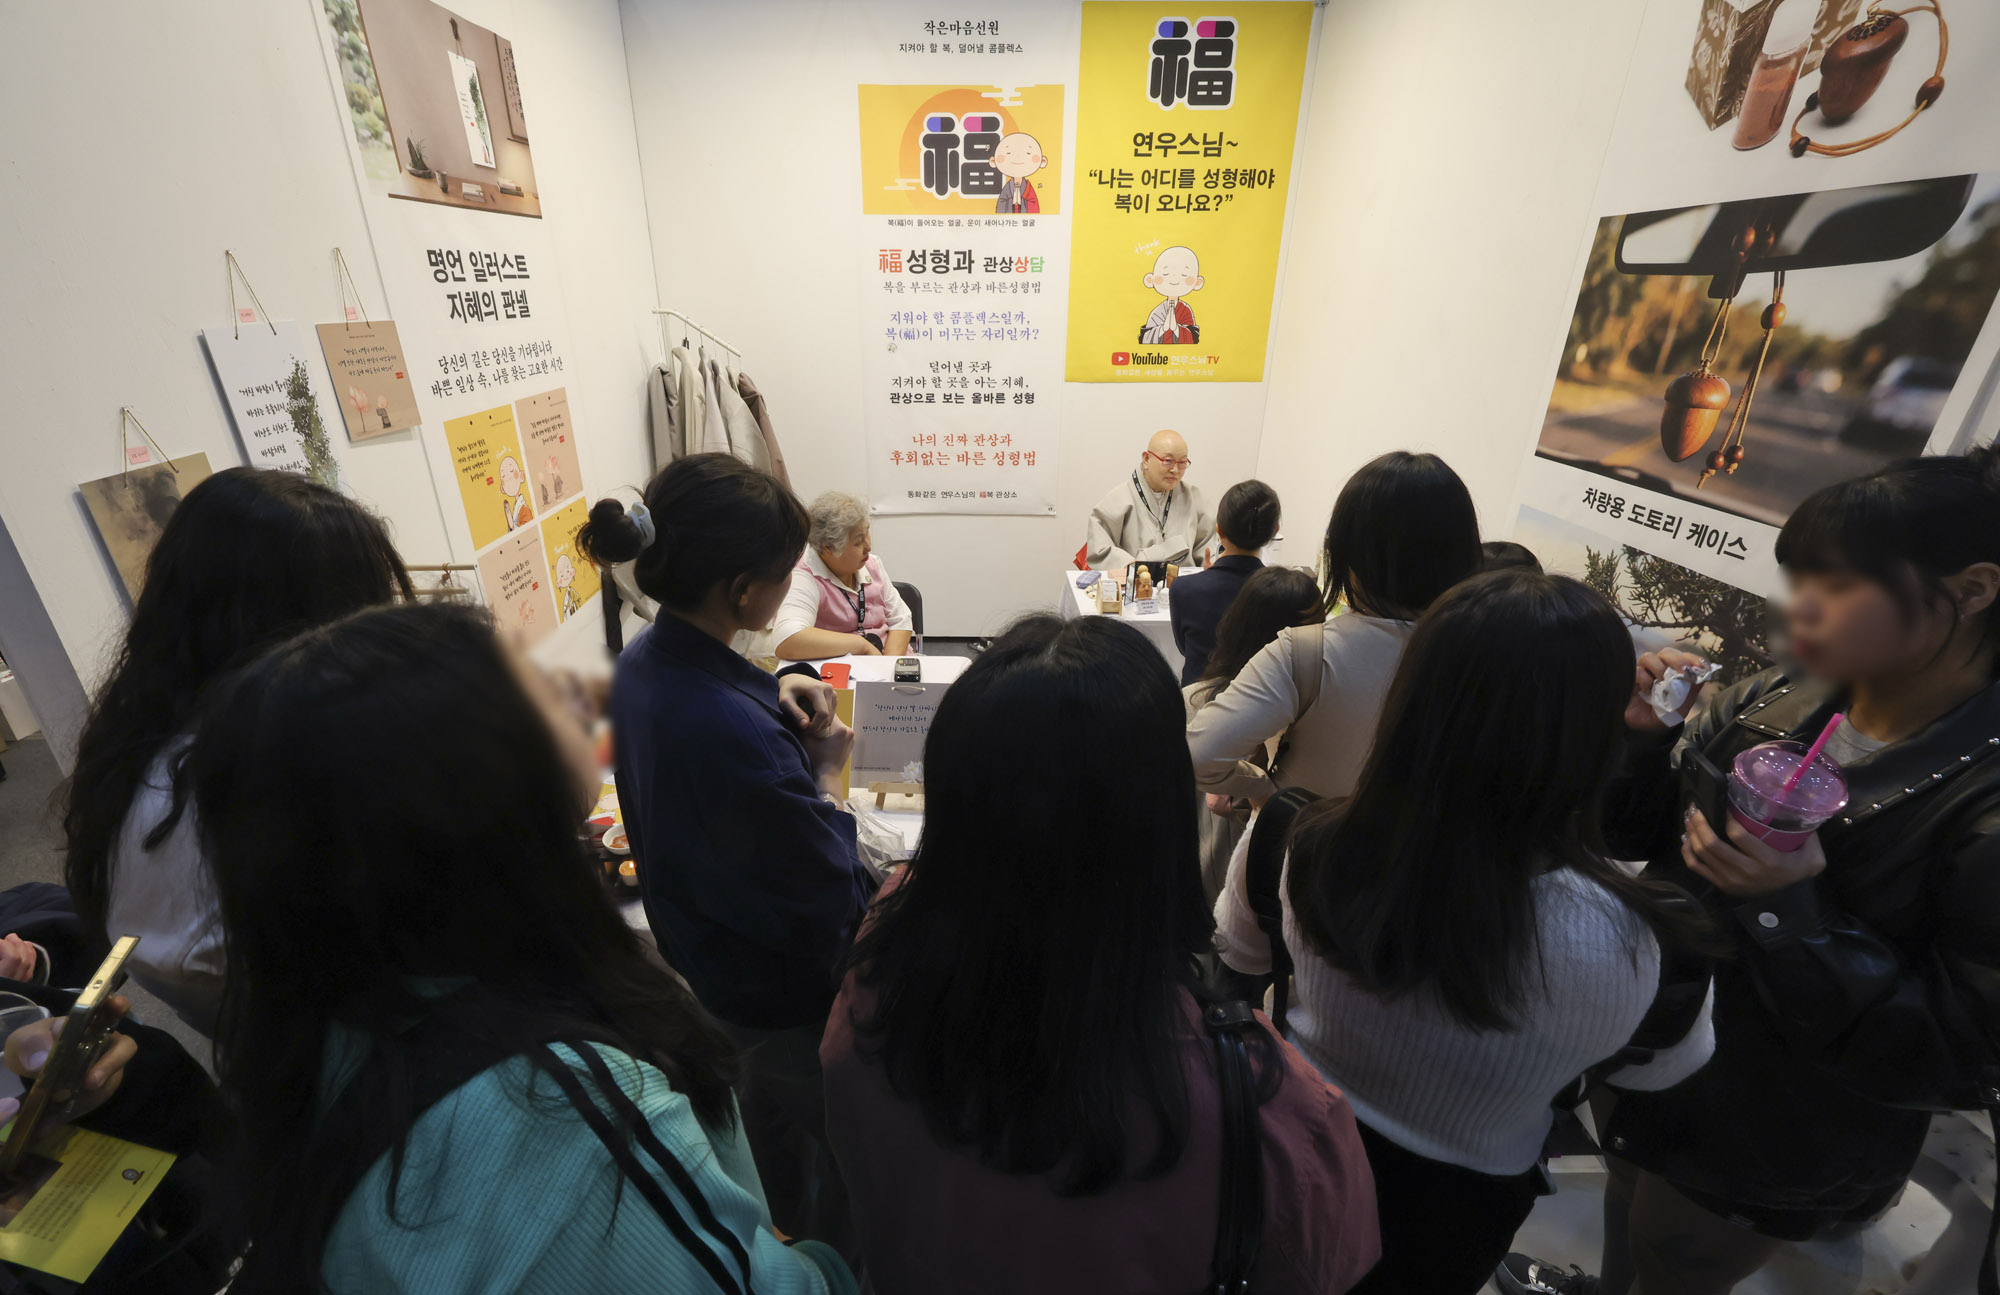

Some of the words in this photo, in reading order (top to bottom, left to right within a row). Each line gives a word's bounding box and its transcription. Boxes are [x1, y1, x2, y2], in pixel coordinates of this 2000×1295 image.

[924, 20, 999, 36] 작은마음선원
[899, 43, 925, 53] 지켜야
[930, 43, 937, 53] 할
[942, 43, 954, 54] 복,
[958, 43, 984, 53] 덜어낼
[989, 43, 1023, 53] 콤플렉스
[1149, 20, 1235, 107] 福
[1133, 132, 1238, 157] 연우스님~
[920, 115, 1002, 197] 福
[1089, 168, 1134, 189] “나는
[1141, 168, 1195, 189] 어디를
[1203, 168, 1275, 189] 성형해야
[1114, 193, 1150, 213] 복이
[1156, 193, 1234, 213] 오나요?”
[1022, 219, 1036, 227] 얼굴
[426, 249, 467, 284] 명언
[469, 251, 530, 283] 일러스트
[879, 249, 902, 274] 福
[906, 249, 975, 274] 성형과
[983, 256, 1045, 274] 관상상담
[884, 281, 905, 294] 복을
[910, 281, 944, 294] 부르는
[948, 281, 981, 294] 관상과
[986, 281, 1041, 294] 바른성형법
[447, 290, 499, 324] 지혜의
[500, 289, 531, 320] 판넬
[890, 311, 928, 325] 지워야
[933, 311, 944, 325] 할
[950, 311, 1030, 325] 콤플렉스일까,
[939, 328, 976, 341] 머무는
[981, 328, 1039, 341] 자리일까?
[438, 353, 469, 375] 당신의
[472, 351, 490, 369] 길은
[492, 346, 516, 365] 당신을
[518, 340, 553, 360] 기다립니다
[1131, 352, 1168, 365] YouTube
[929, 361, 964, 374] 덜어낼
[968, 361, 992, 374] 곳과
[431, 379, 453, 399] 바쁜
[455, 374, 474, 395] 일상
[477, 372, 491, 389] 속,
[493, 368, 509, 385] 나를
[511, 365, 526, 382] 찾는
[528, 360, 548, 377] 고요한
[550, 356, 563, 372] 시간
[892, 376, 927, 389] 지켜야
[932, 376, 942, 389] 할
[947, 376, 970, 389] 곳을
[975, 376, 997, 389] 아는
[1002, 376, 1029, 389] 지혜,
[890, 393, 936, 404] 관상으로
[942, 393, 965, 404] 보는
[972, 393, 1006, 404] 올바른
[1013, 393, 1035, 404] 성형
[912, 433, 937, 447] 나의
[944, 433, 968, 447] 진짜
[974, 433, 1012, 447] 관상과
[890, 450, 950, 467] 후회없는
[957, 450, 986, 467] 바른
[993, 450, 1036, 467] 성형법
[1582, 487, 1626, 519] 차량용
[1627, 503, 1683, 539] 도토리
[1686, 522, 1748, 560] 케이스
